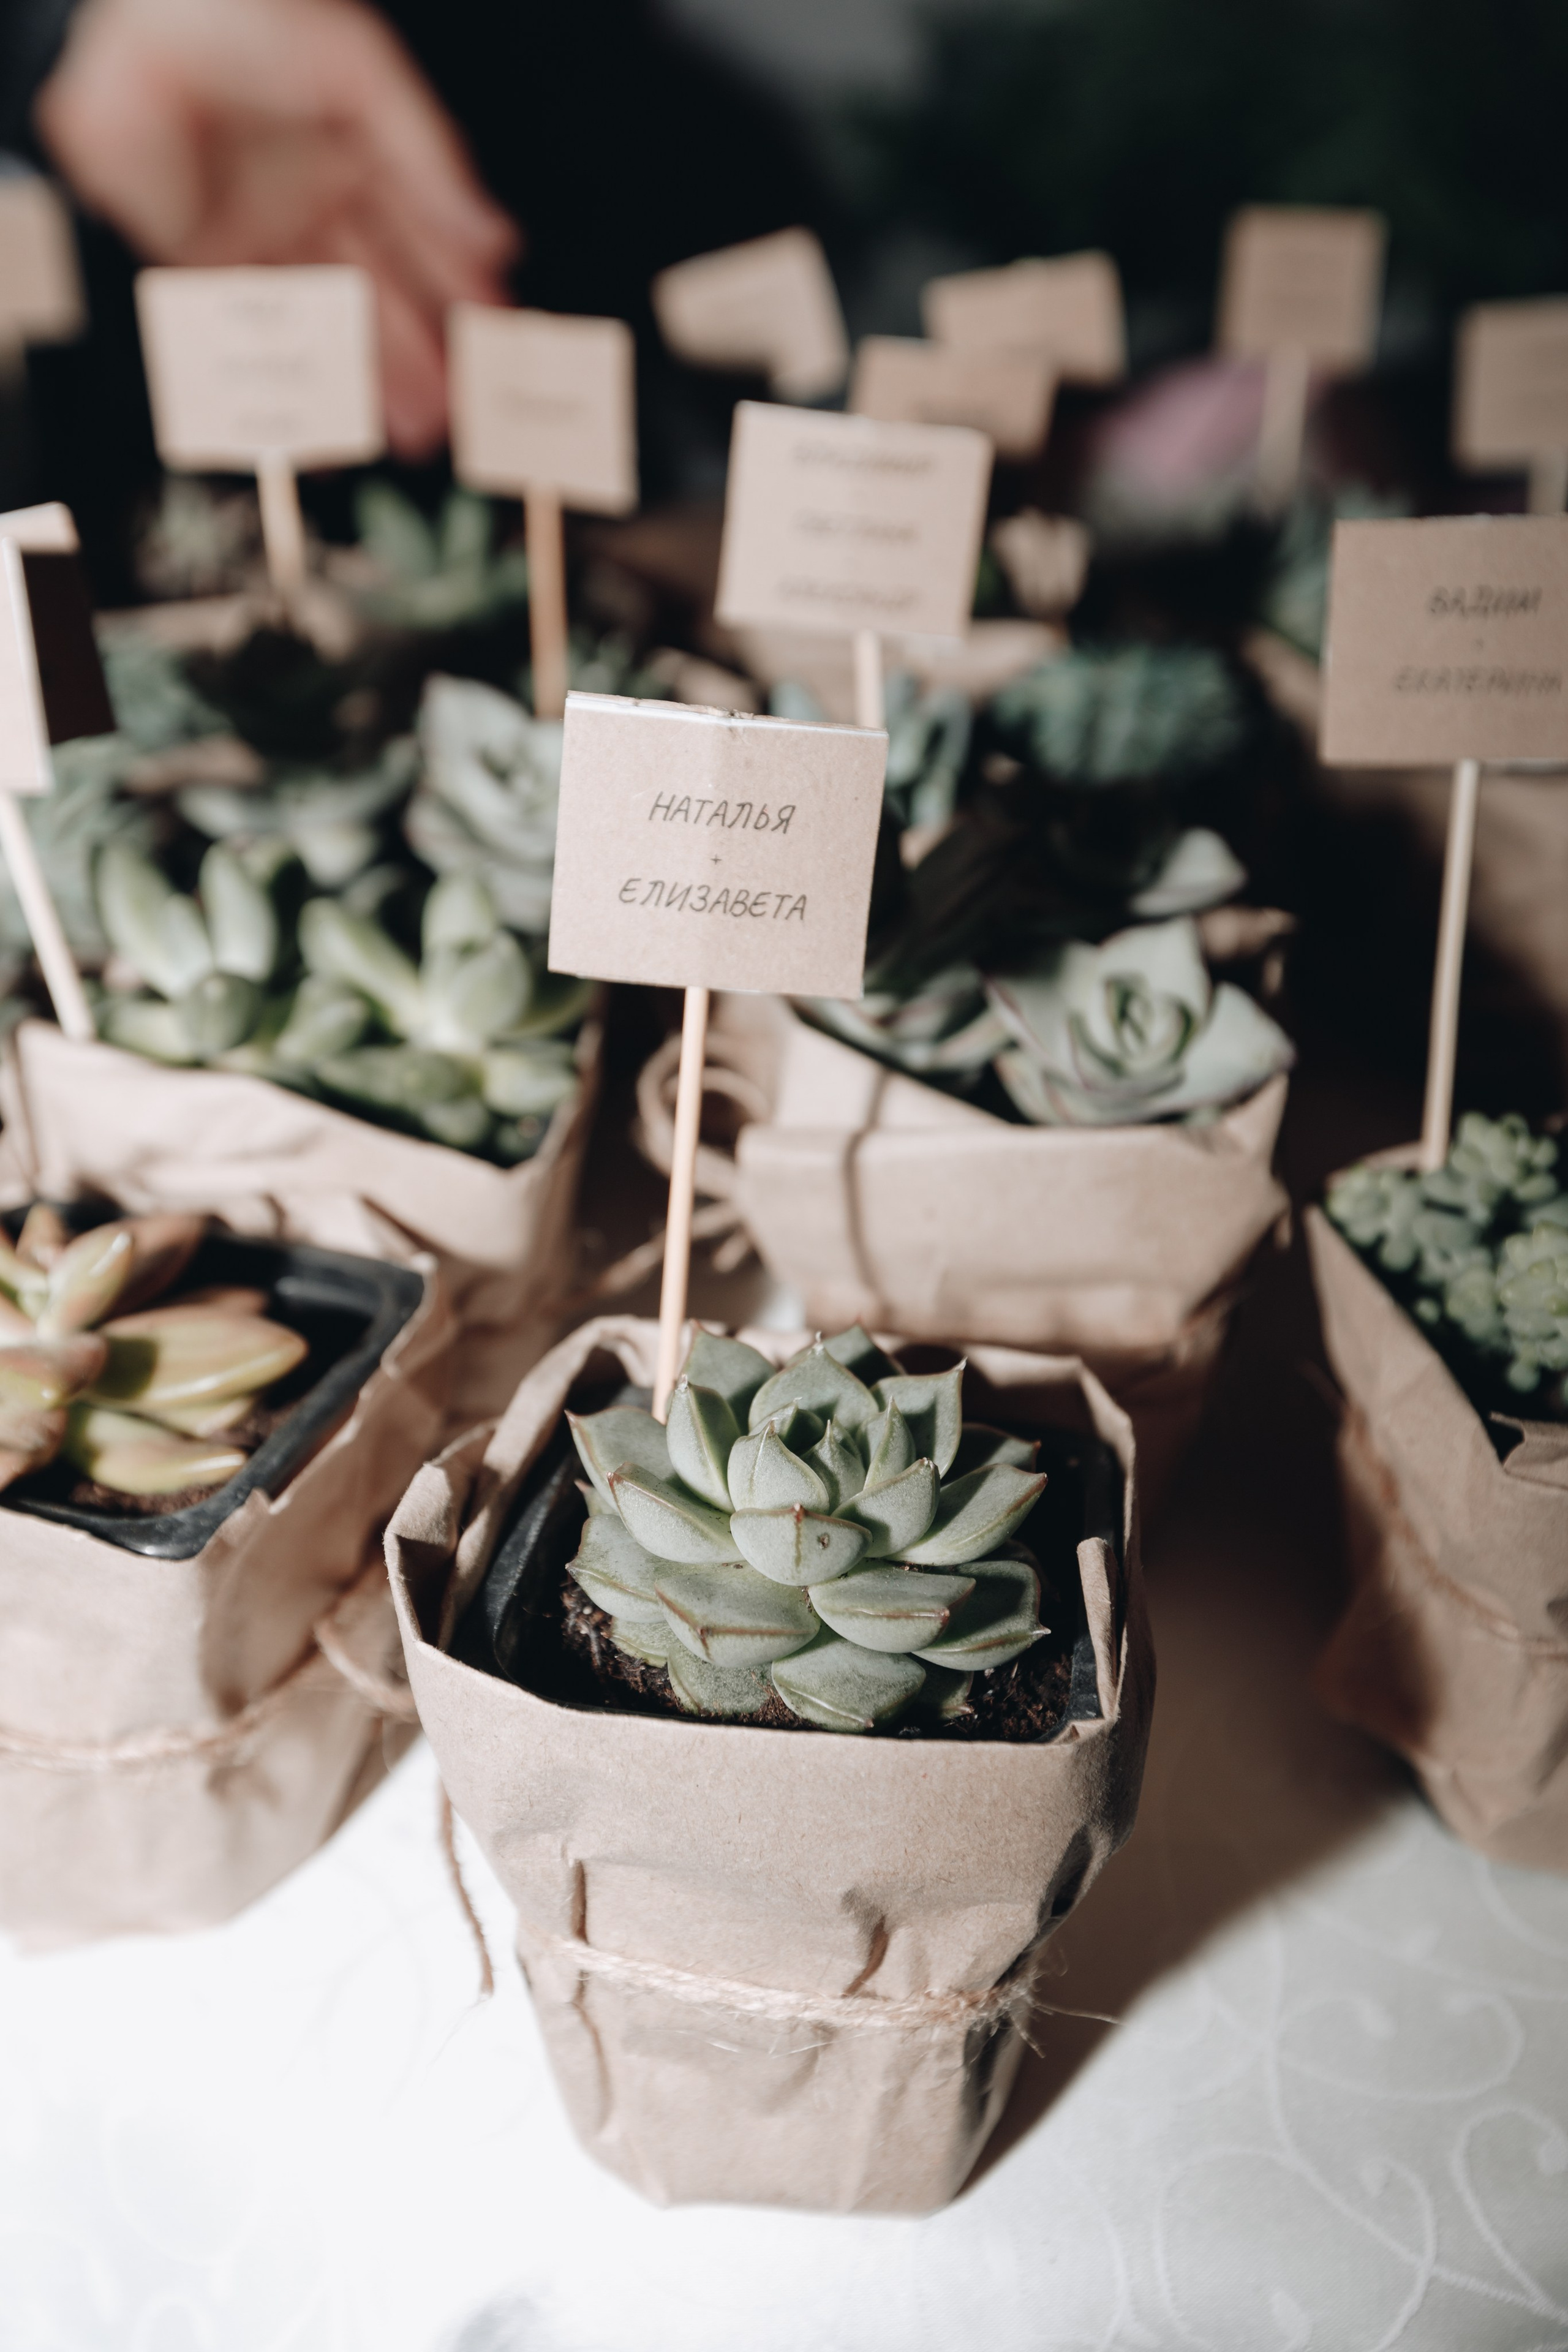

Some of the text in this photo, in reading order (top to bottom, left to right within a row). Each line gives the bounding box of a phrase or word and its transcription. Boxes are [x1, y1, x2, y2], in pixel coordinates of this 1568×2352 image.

[649, 791, 796, 834] НАТАЛЬЯ
[710, 854, 722, 865] +
[619, 878, 808, 920] ЕЛИЗАВЕТА
